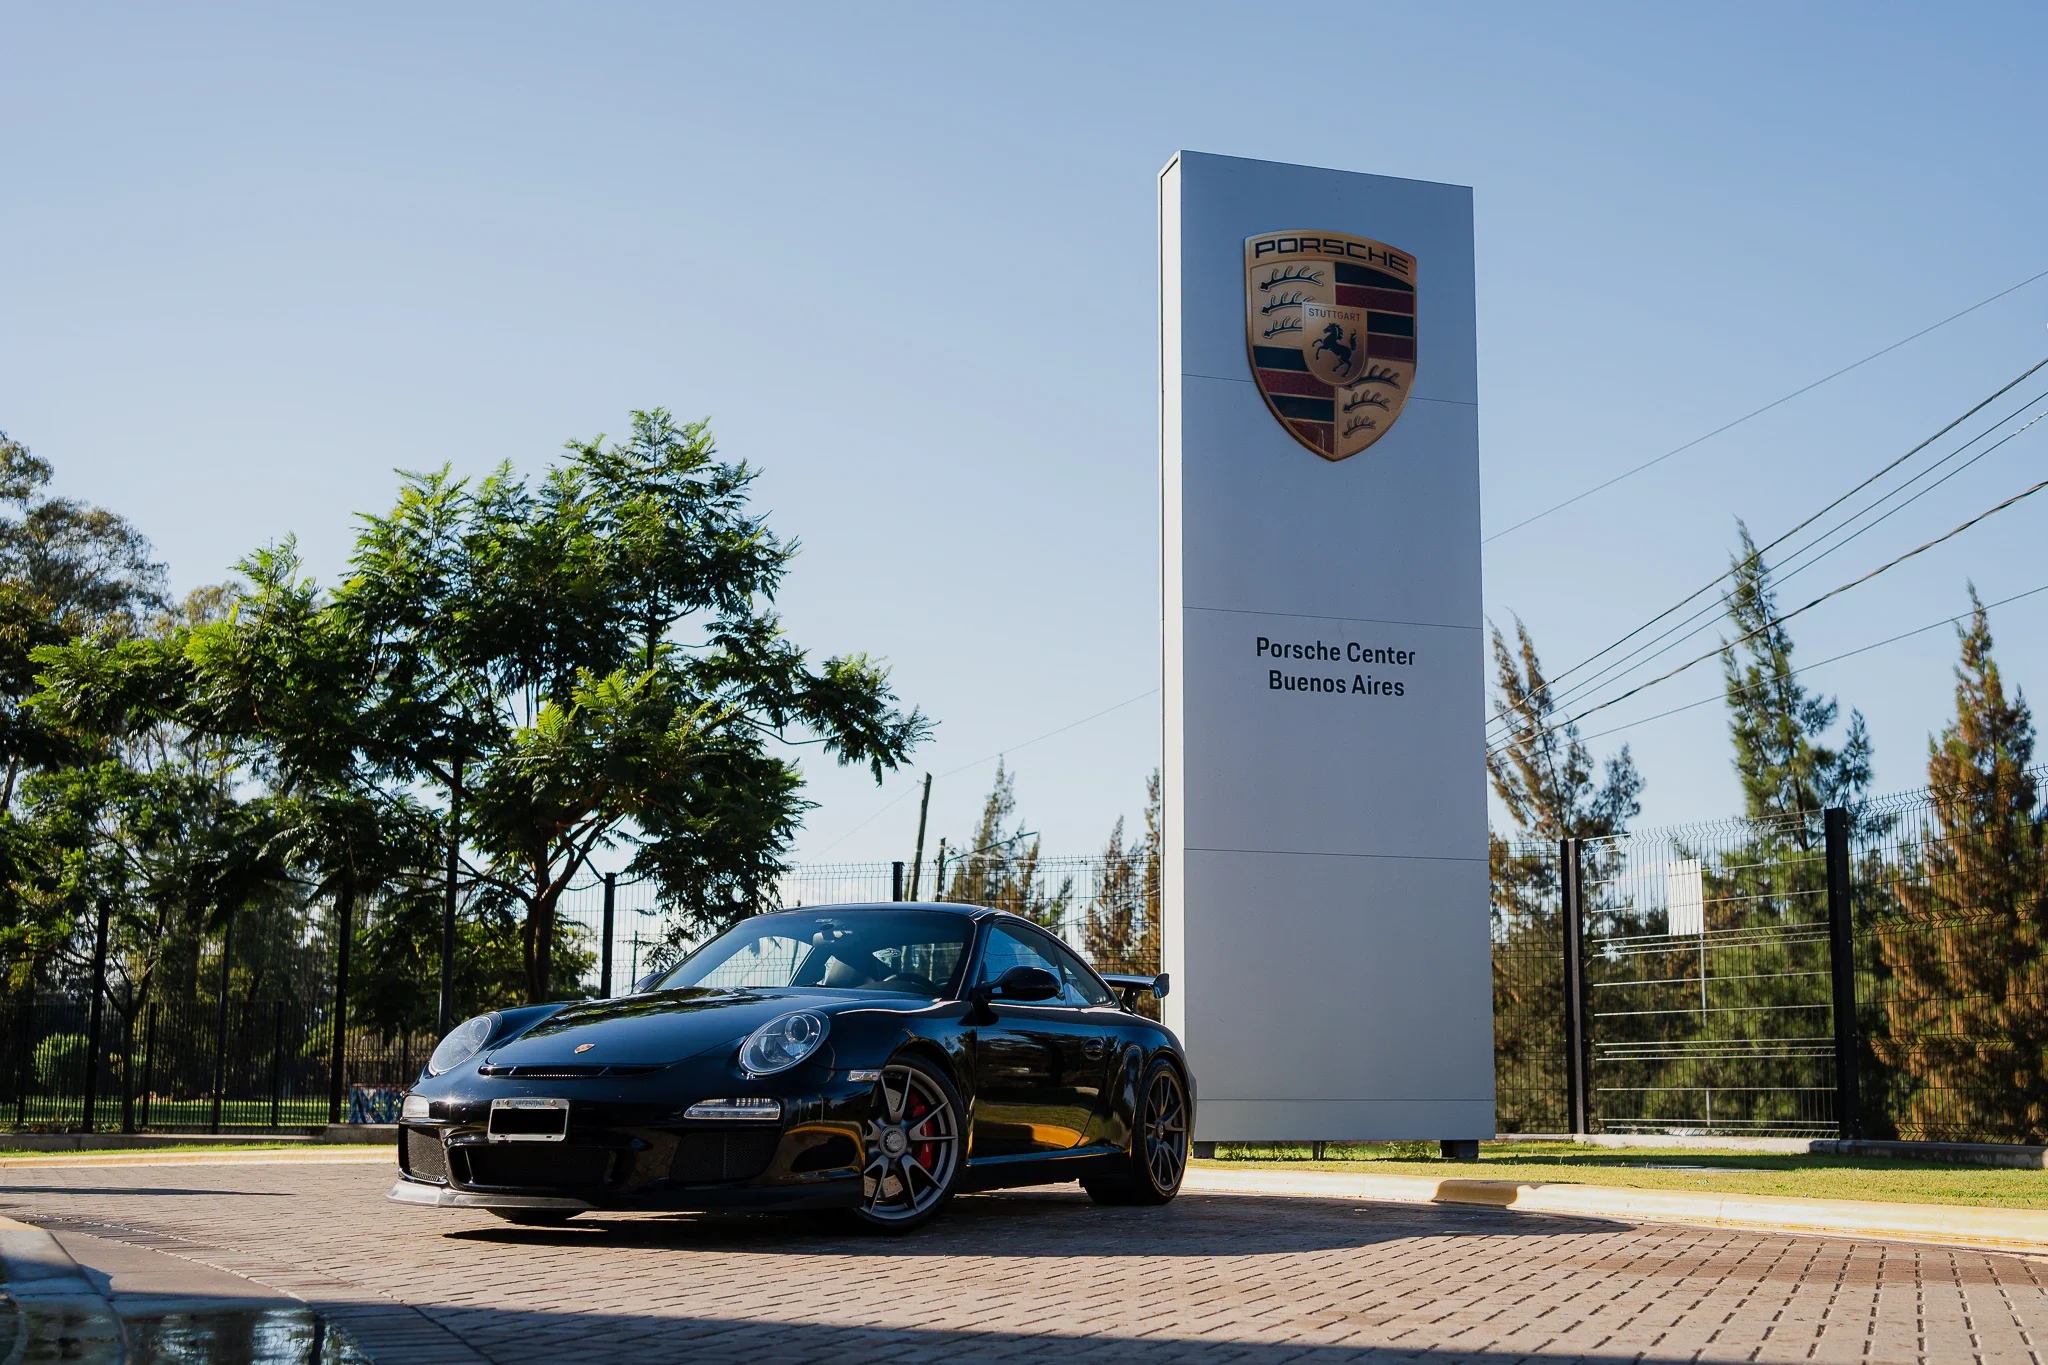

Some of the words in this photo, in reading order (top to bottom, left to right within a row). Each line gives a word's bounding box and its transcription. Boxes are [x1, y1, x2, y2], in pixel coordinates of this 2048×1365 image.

[1255, 237, 1409, 276] PORSCHE
[1308, 307, 1361, 322] STUTTGART
[1256, 636, 1341, 662] Porsche
[1346, 642, 1416, 666] Center
[1268, 669, 1347, 694] Buenos
[1351, 674, 1405, 697] Aires
